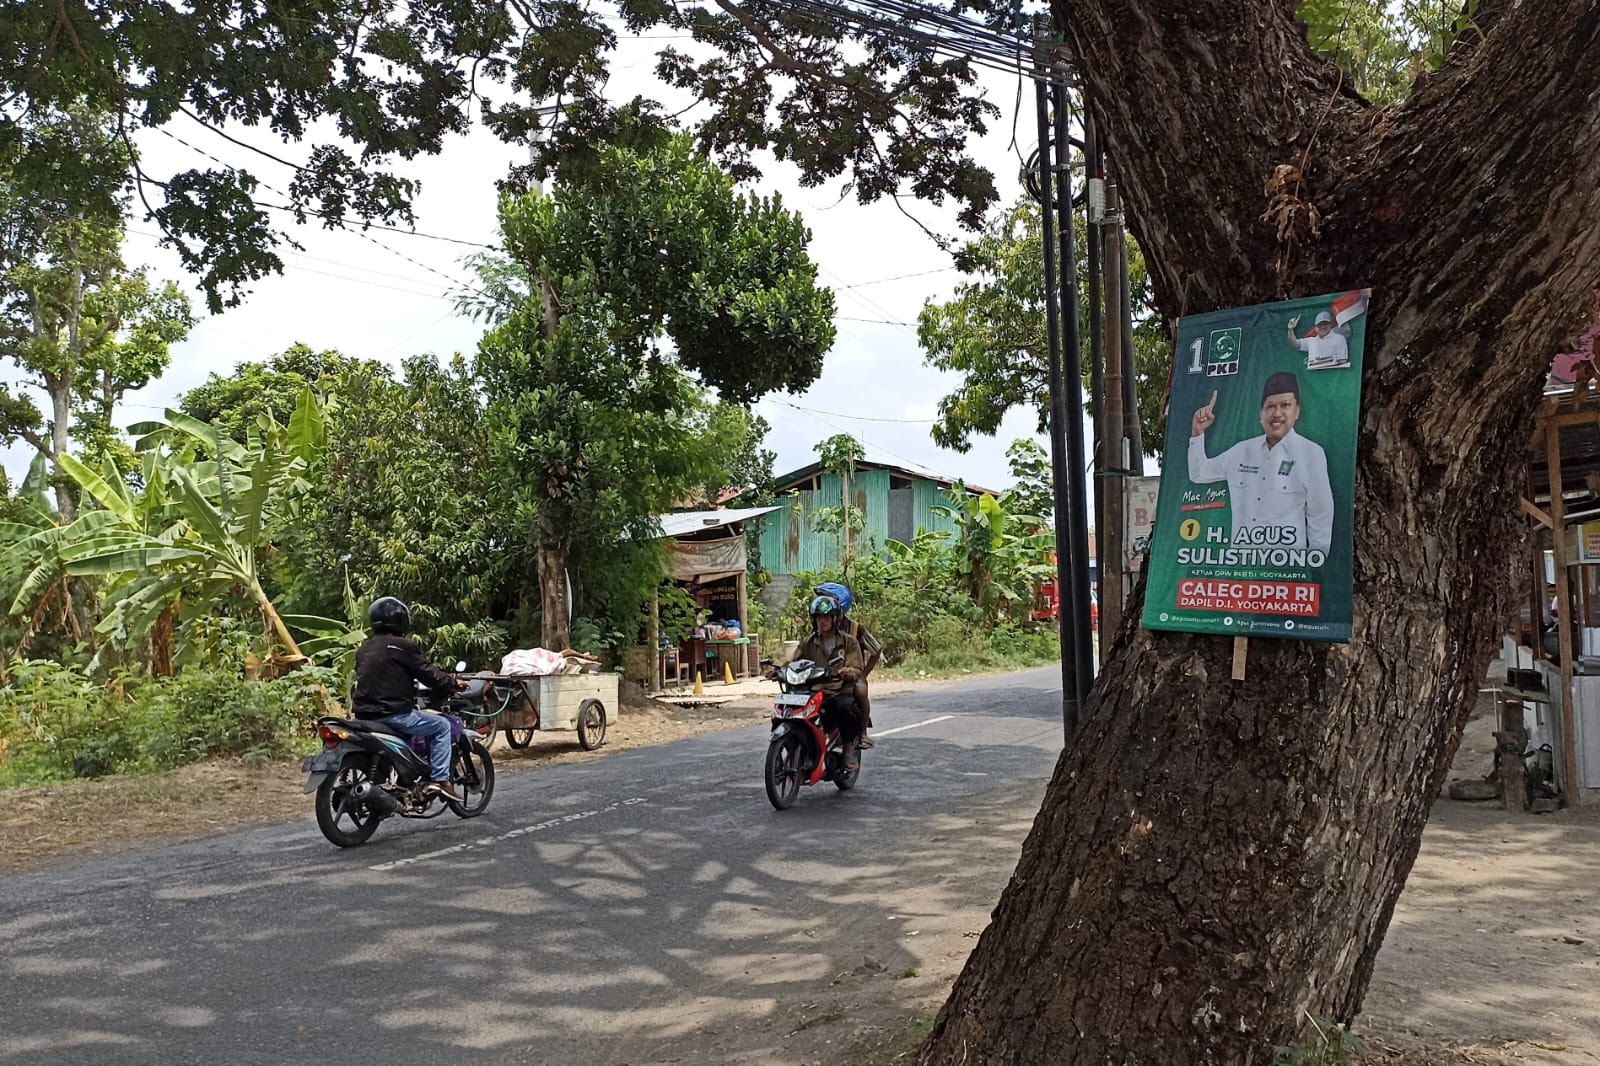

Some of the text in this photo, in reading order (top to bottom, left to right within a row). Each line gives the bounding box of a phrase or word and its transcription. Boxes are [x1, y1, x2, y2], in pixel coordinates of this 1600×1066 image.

[1189, 338, 1203, 373] 1
[1207, 362, 1238, 375] PKB
[1206, 526, 1296, 544] H. AGUS
[1177, 547, 1325, 568] SULISTIYONO
[1191, 569, 1213, 577] KETUA
[1181, 582, 1315, 602] CALEG DPR RI
[1181, 598, 1313, 613] DAPIL D.I. YOGYAKARTA
